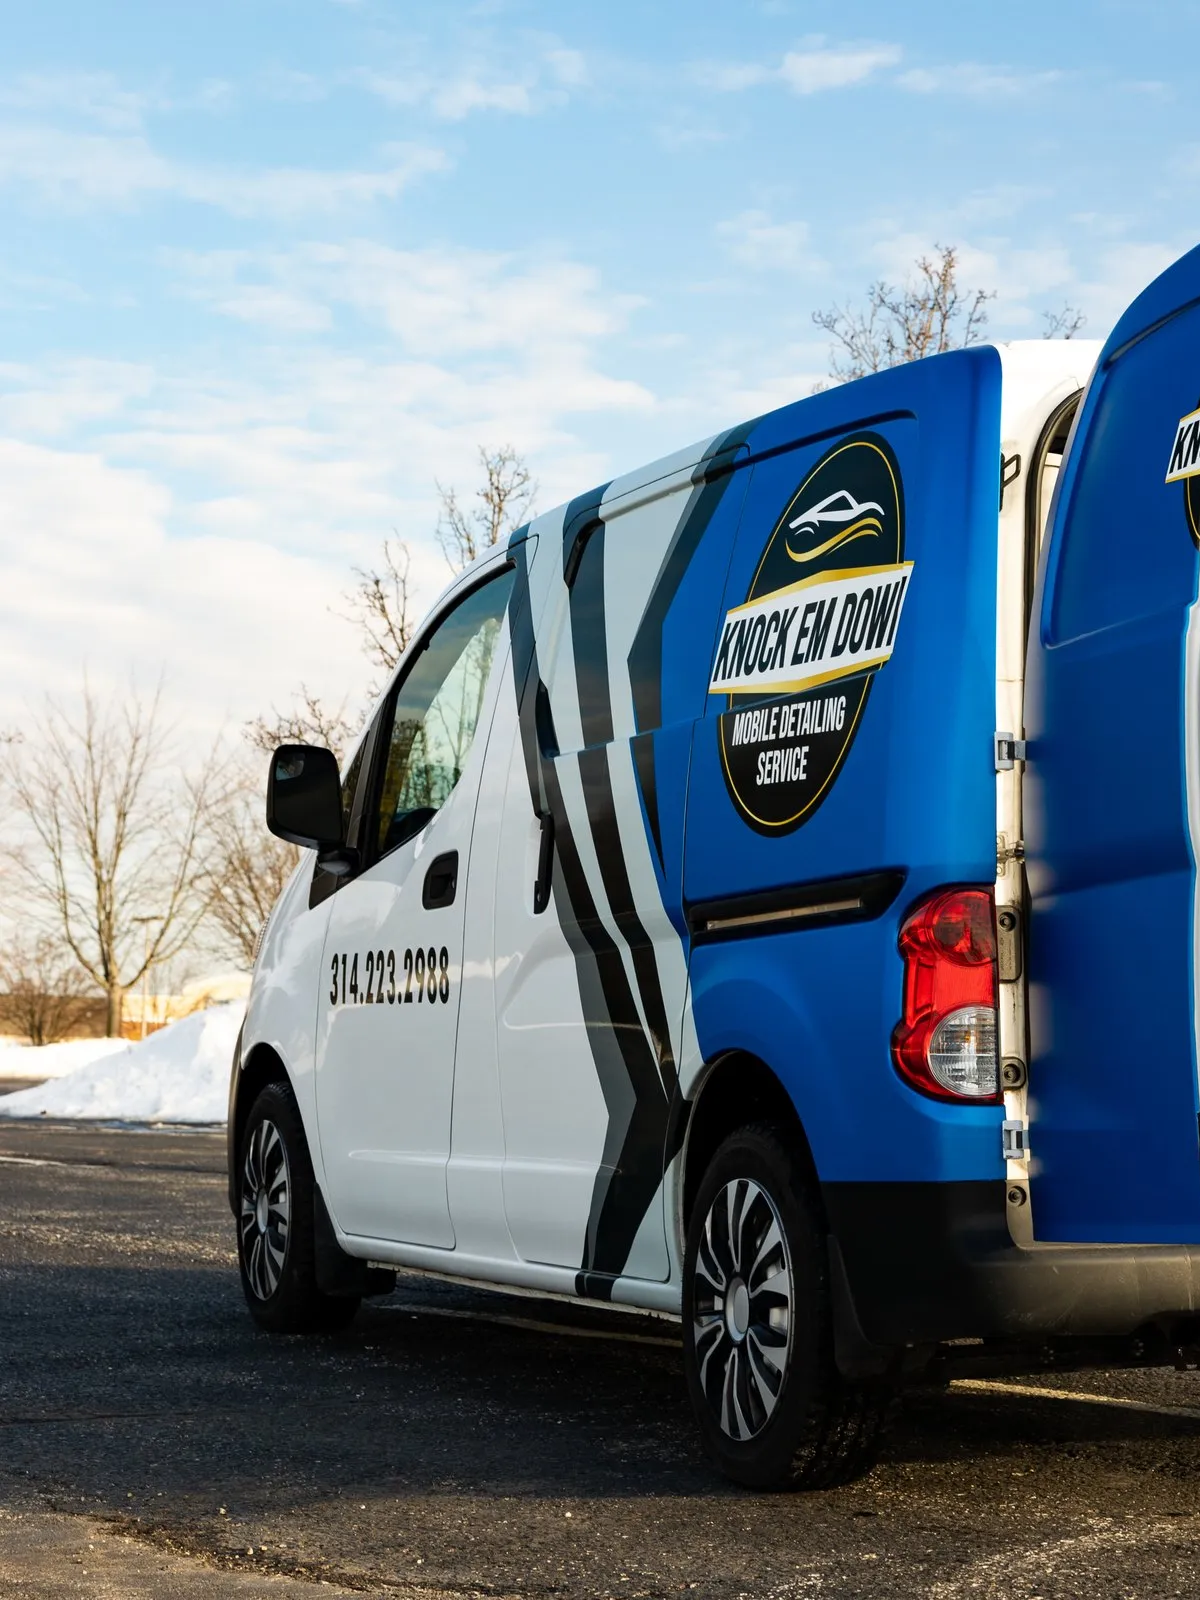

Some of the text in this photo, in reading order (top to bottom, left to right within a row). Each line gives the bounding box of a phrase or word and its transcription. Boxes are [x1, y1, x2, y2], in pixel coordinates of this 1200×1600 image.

[713, 606, 799, 682] KNOCK
[790, 596, 838, 666] EM
[732, 696, 847, 746] MOBILE DETAILING
[756, 746, 809, 785] SERVICE
[330, 946, 449, 1005] 314.223.2988
